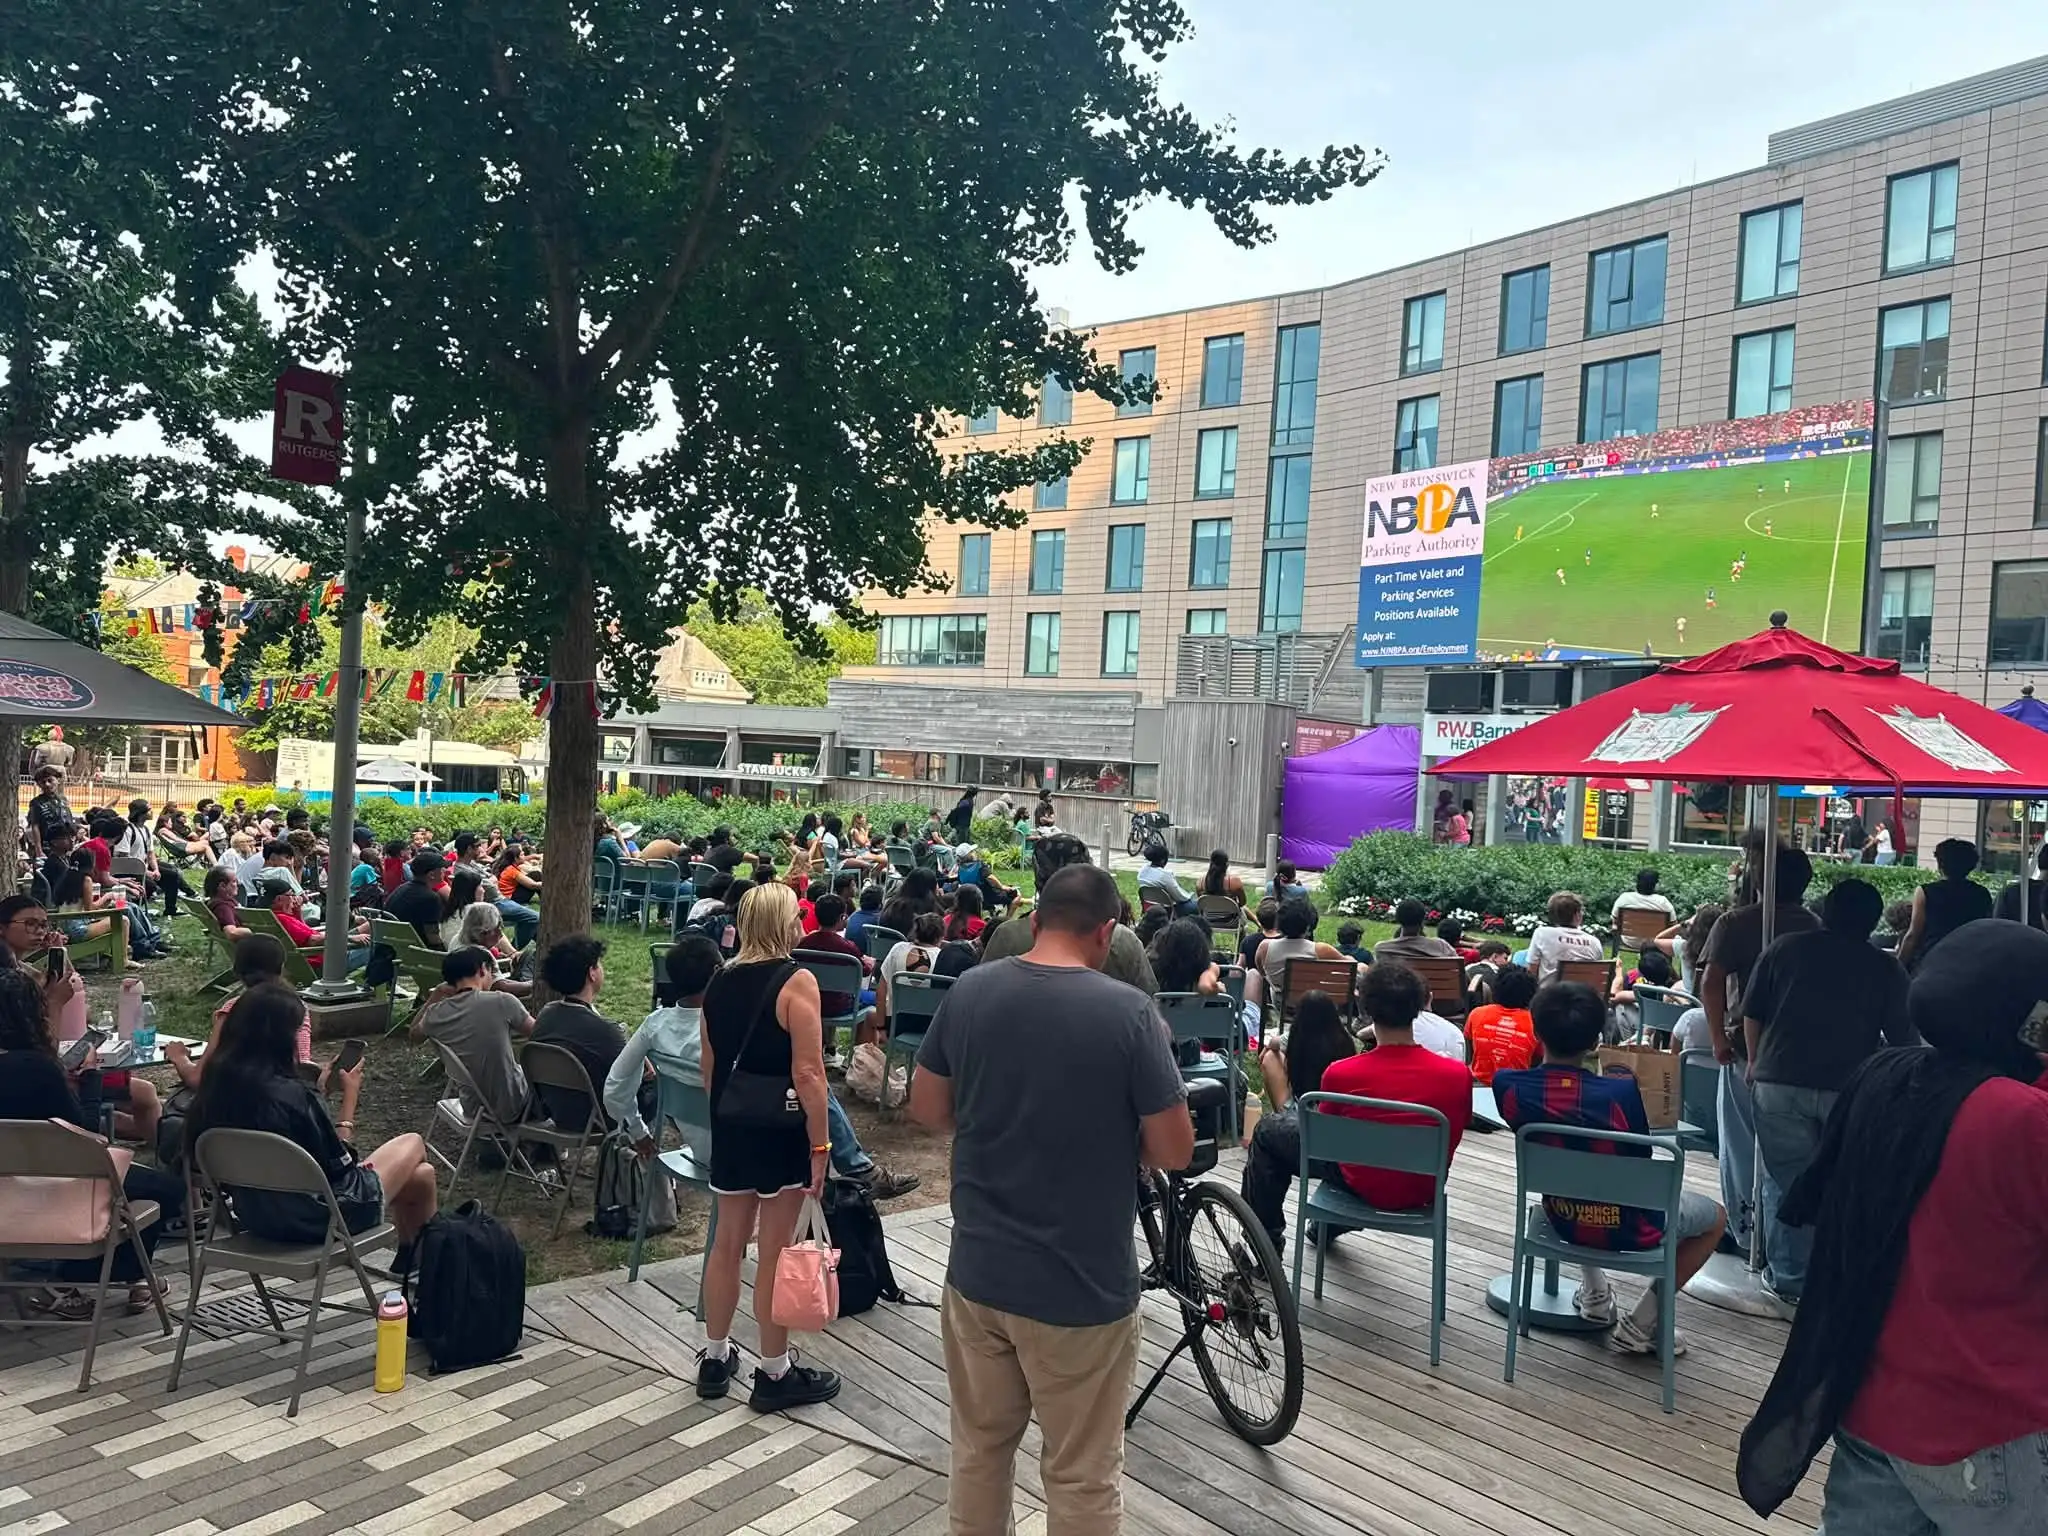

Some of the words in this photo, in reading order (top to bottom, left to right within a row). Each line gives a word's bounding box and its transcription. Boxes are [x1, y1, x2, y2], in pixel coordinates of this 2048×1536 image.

[281, 389, 337, 446] R
[1830, 419, 1854, 433] FOX
[1820, 431, 1846, 441] DALLAS
[279, 440, 337, 461] RUTGERS
[1370, 481, 1397, 494] NEW
[1402, 467, 1477, 489] BRUNSWICK
[1367, 486, 1481, 539] NBPA
[1365, 542, 1412, 559] Parking
[1416, 534, 1480, 553] Authority
[1375, 573, 1393, 584] Part
[1395, 571, 1418, 582] Time
[1420, 567, 1444, 580] Valet
[1446, 565, 1465, 577] and
[1381, 590, 1415, 602] Parking
[1416, 587, 1455, 600] Services
[1374, 609, 1414, 621] Positions
[1416, 605, 1460, 618] Available
[1362, 631, 1384, 643] Apply
[1385, 631, 1396, 640] at:
[1437, 721, 1529, 739] RWJBarn
[737, 763, 809, 777] STARBUCKS
